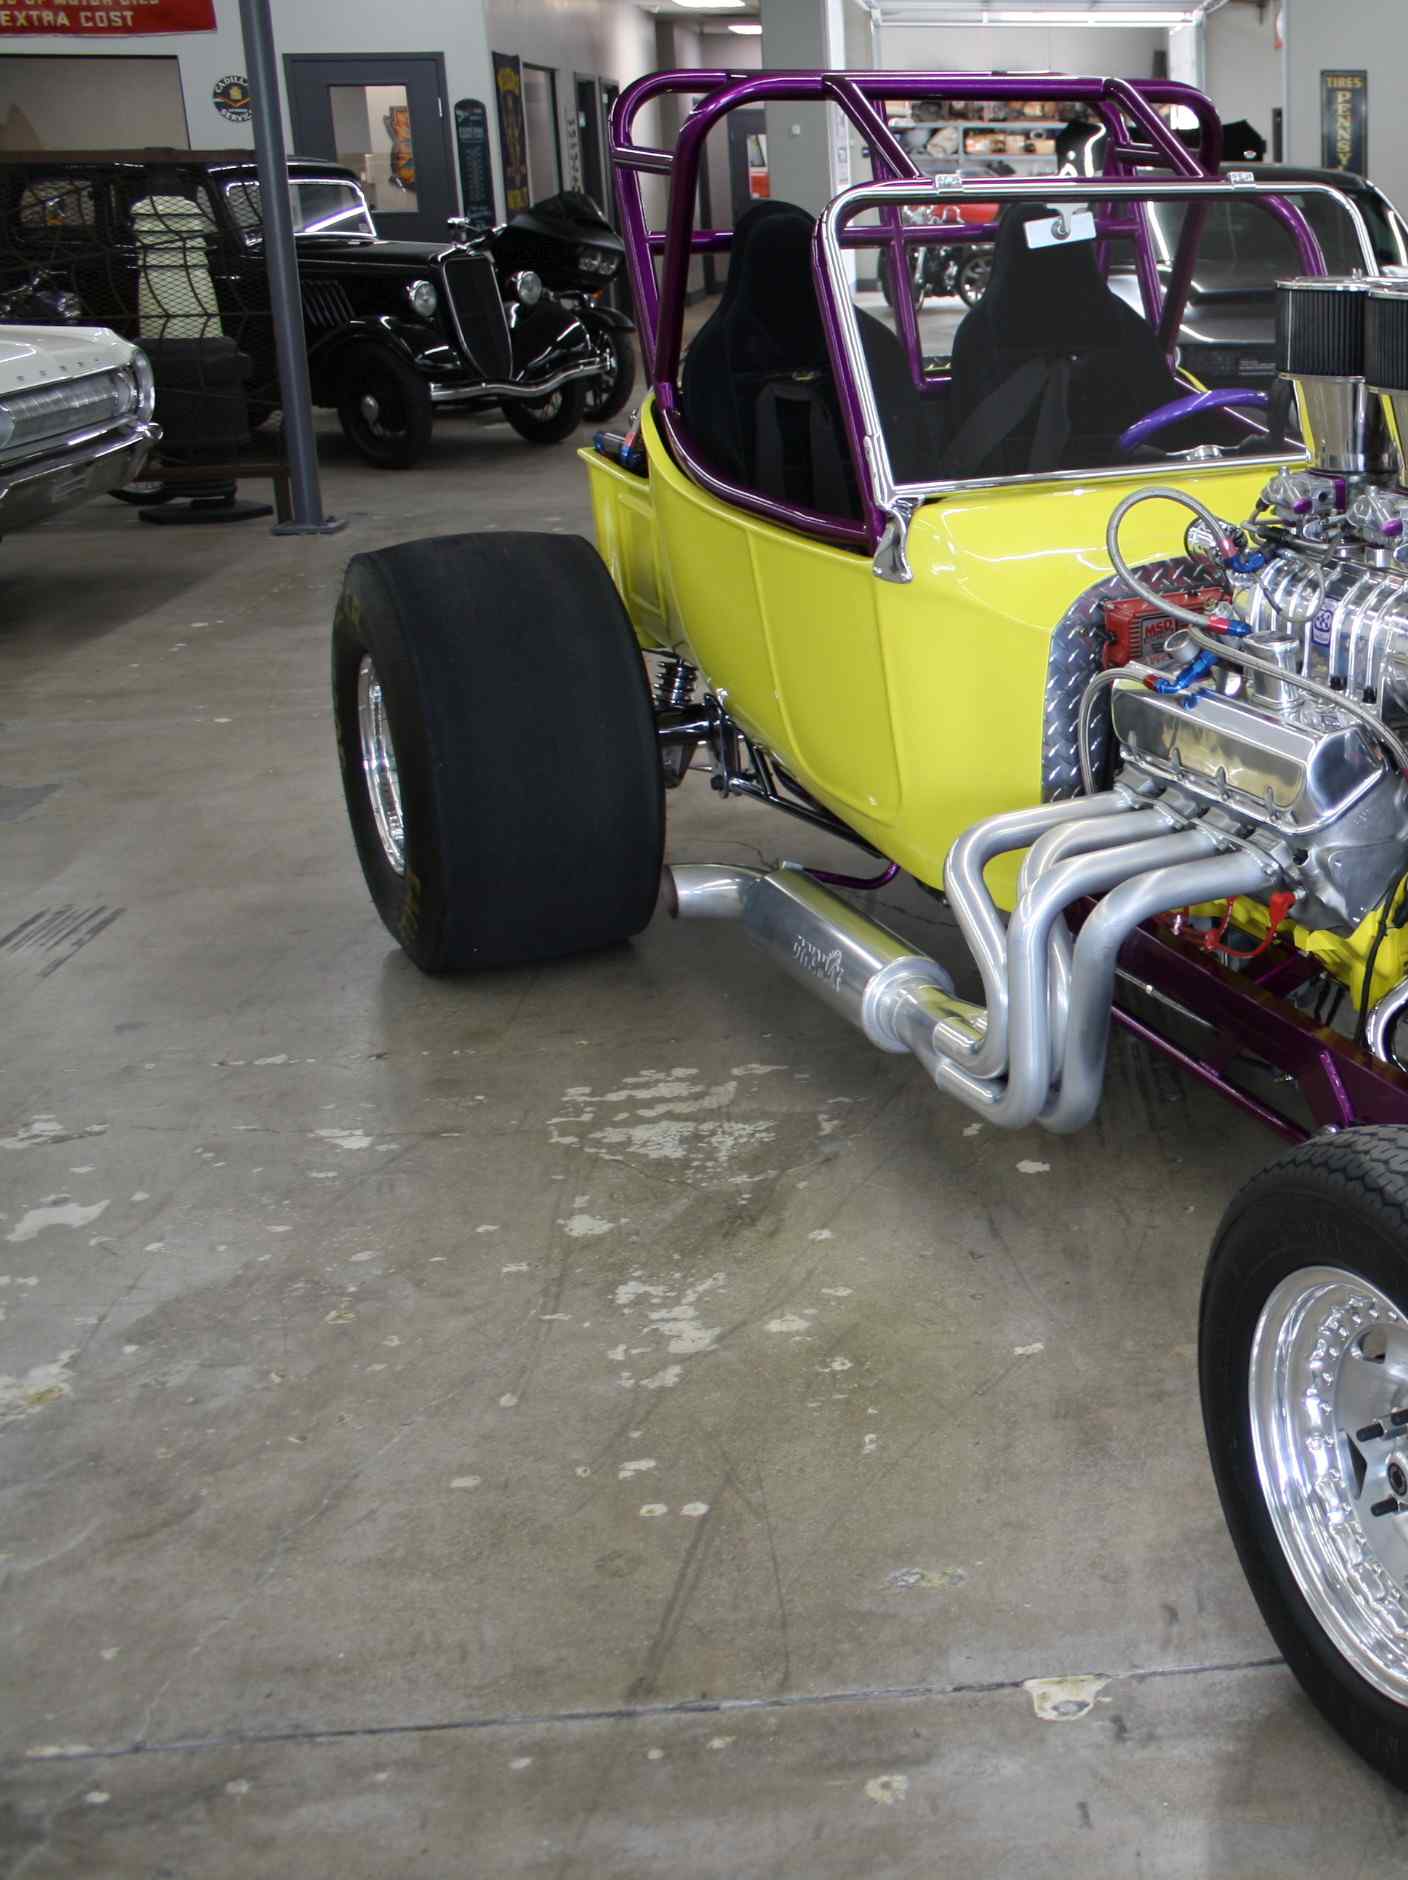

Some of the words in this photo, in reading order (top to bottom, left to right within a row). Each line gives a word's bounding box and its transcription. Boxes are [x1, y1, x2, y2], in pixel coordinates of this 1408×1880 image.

[1, 11, 70, 27] EXTRA
[80, 11, 134, 27] COST
[1327, 76, 1364, 88] TIRES
